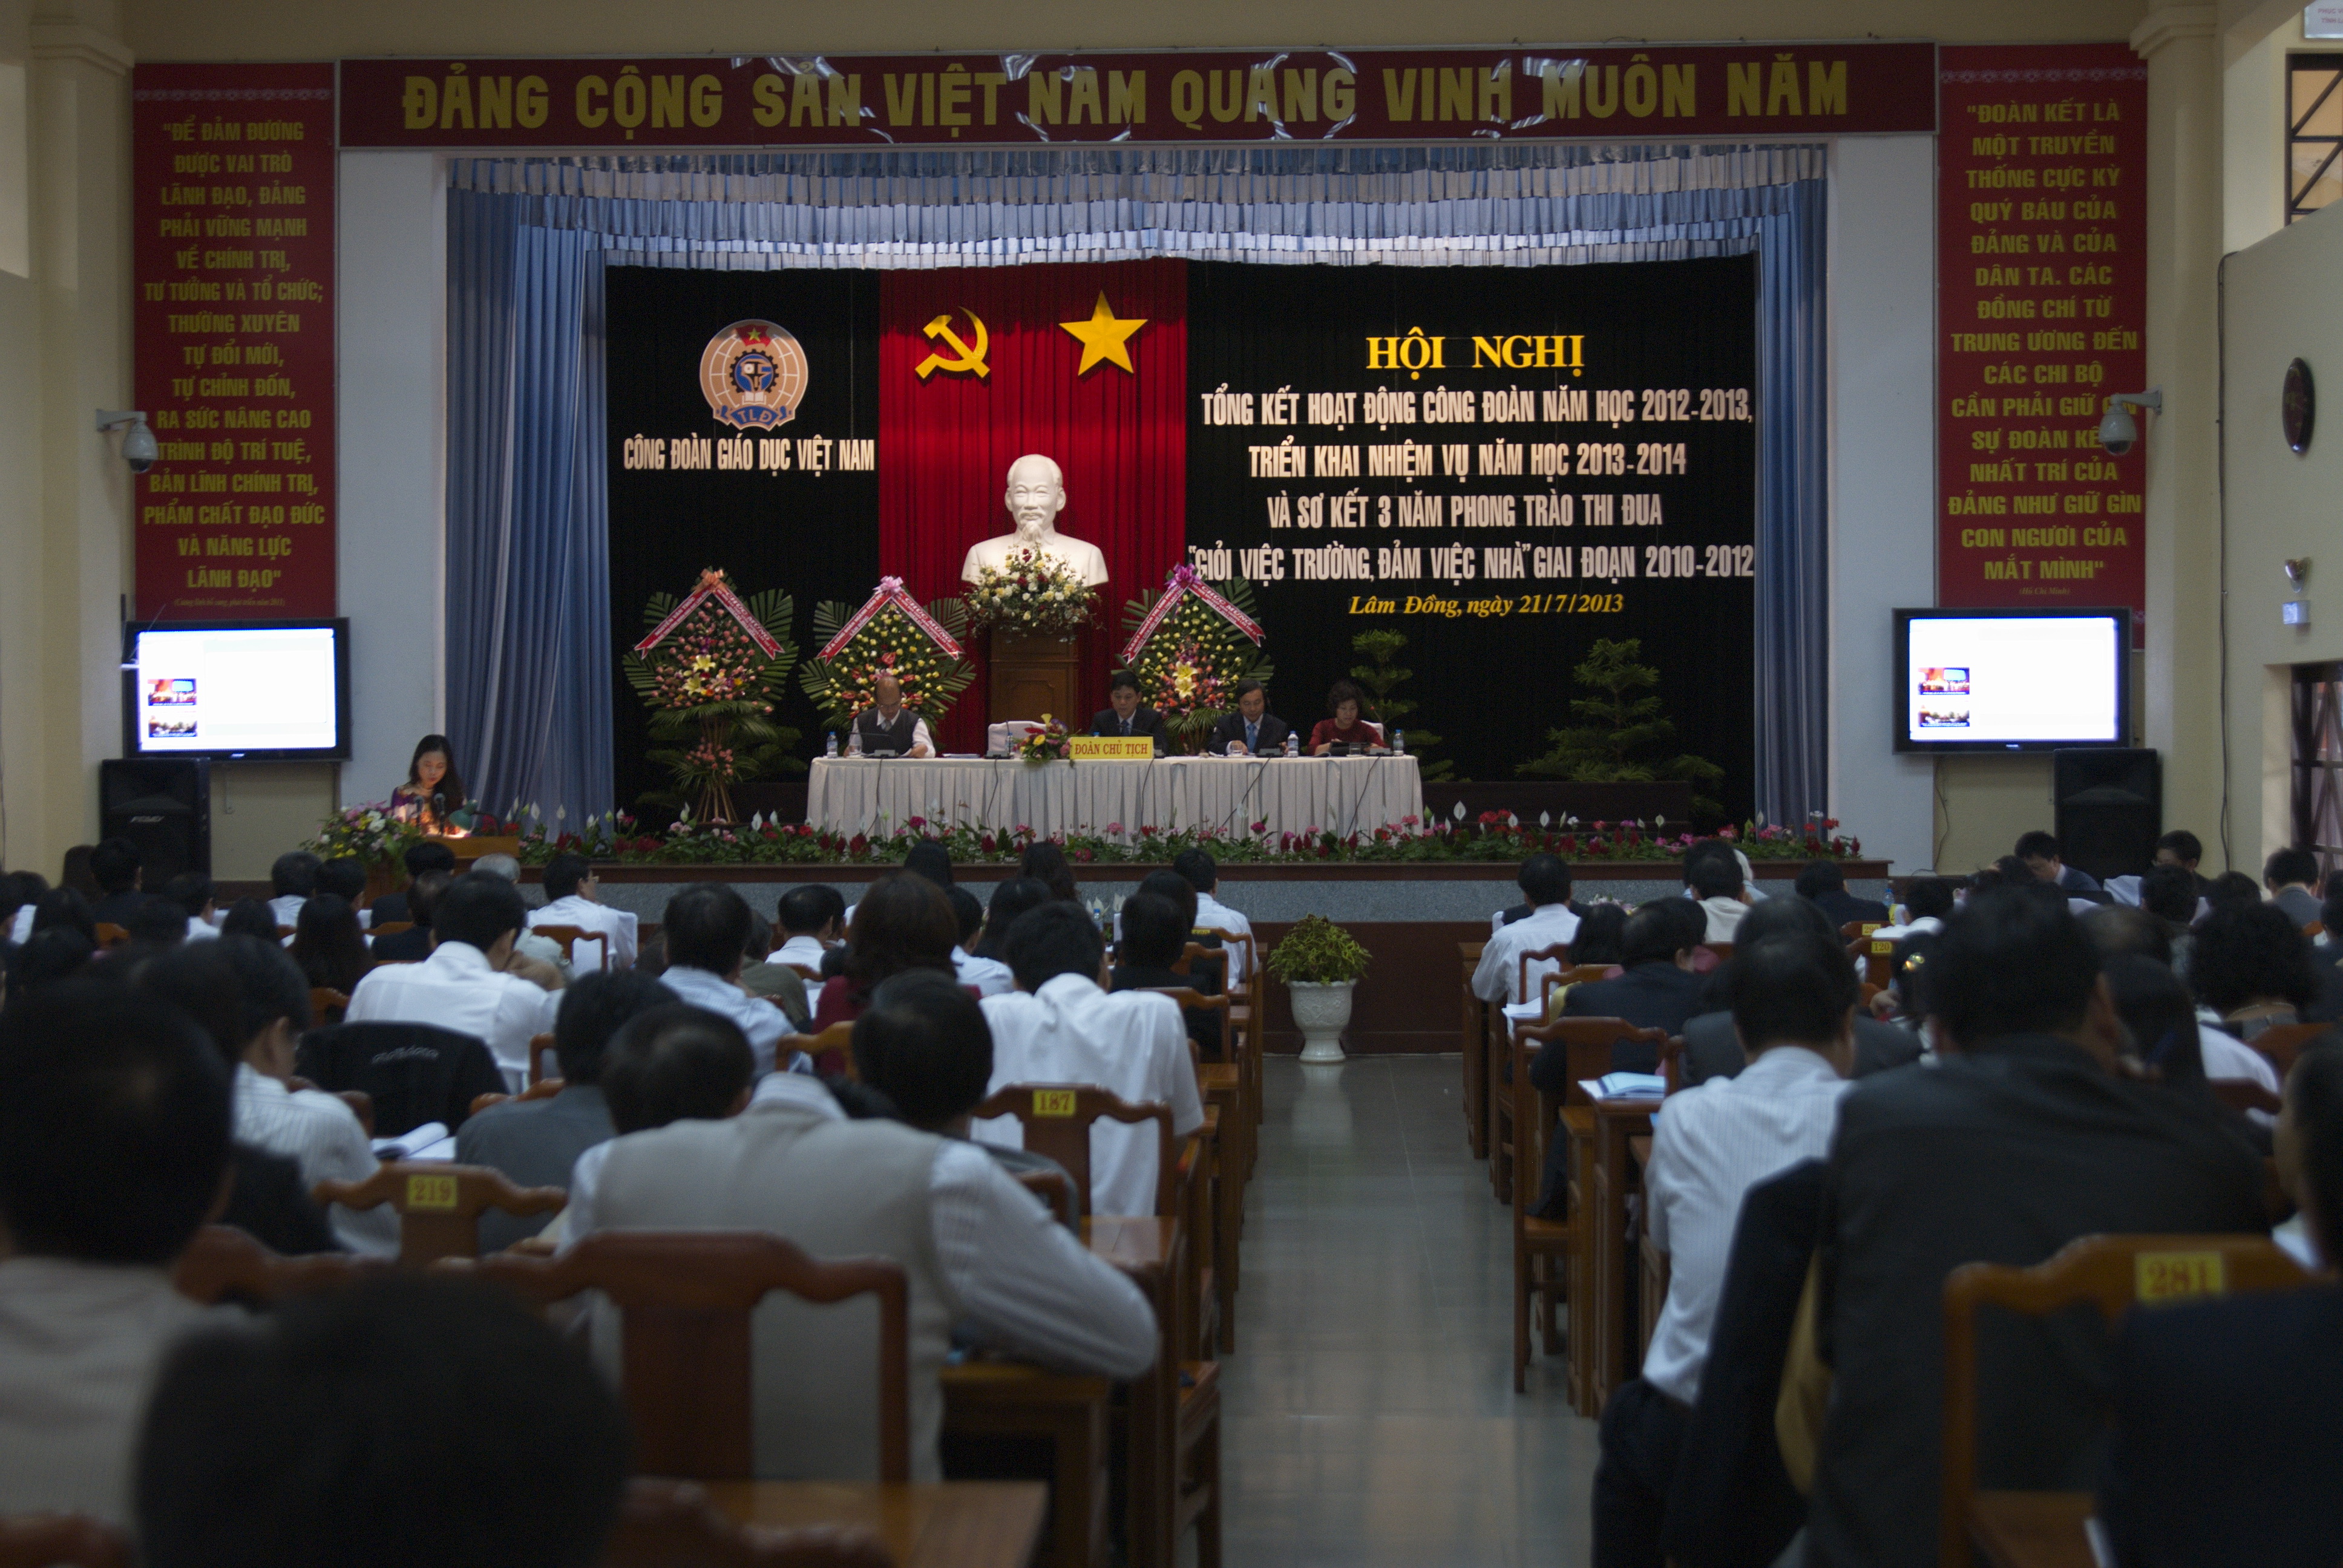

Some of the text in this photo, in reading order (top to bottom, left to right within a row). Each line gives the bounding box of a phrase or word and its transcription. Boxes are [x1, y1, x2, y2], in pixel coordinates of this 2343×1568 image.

[401, 53, 1848, 140] ĐẢNG CỘNG SẢN VIỆT NAM QUANG VINH MUÔN NĂM
[2044, 97, 2120, 122] KẾT LÀ
[201, 116, 304, 140] ĐẢM ĐƯƠNG
[1972, 128, 2115, 160] MỘT TRUYỀN
[174, 152, 254, 178] ĐƯỢC VAI
[1965, 163, 2122, 192] THỐNG CỰC KỲ
[161, 180, 306, 209] LÃNH ĐẠO, ĐẢNG
[1970, 194, 2117, 224] QUÝ BÁU CỦA
[160, 212, 307, 241] PHẢI VỮNG MẠNH
[1971, 227, 2117, 254] ĐẢNG VÀ CỦA
[205, 247, 290, 273] CHÍNH TRỊ,
[1976, 263, 2112, 286] DÂN TA. CÁC
[144, 280, 166, 301] TƯ
[226, 278, 246, 301] VÀ
[252, 275, 272, 301] TỔ
[1977, 293, 2113, 319] ĐỒNG CHÍ TỪ
[241, 310, 300, 333] XUYÊN
[1951, 325, 2138, 351] TRUNG ƯƠNG ĐẾN
[184, 345, 206, 370] TỰ
[211, 339, 240, 364] ĐỔI
[1366, 326, 1585, 381] HỘI NGHỊ
[1984, 361, 2103, 387] CÁC CHI BỘ
[172, 373, 296, 402] TỰ CHỈNH ĐỐN,
[738, 410, 772, 423] TLĐ
[1201, 382, 1753, 431] TỔNG KẾT HOẠT ĐỘNG CÔNG ĐOÀN NĂM HỌC 2012-2013,
[1951, 391, 2097, 417] CẦN PHẢI GIỮ
[157, 407, 312, 429] RA SỨC NÂNG CAO
[159, 439, 312, 465] TRÌNH ĐỘ TRÍ TUỆ,
[1972, 426, 2068, 454] SỰ ĐOÀN
[624, 432, 874, 477] CÔNG ĐOÀN GIÁO DỤC VIỆT NAM
[1248, 434, 1686, 483] TRIỂN KHAI NHIỆM VỤ NĂM HỌC 2013-2014
[150, 468, 318, 495] BẢN LĨNH CHÍNH TRỊ,
[1970, 456, 2117, 483] NHẤT TRÍ CỦA
[144, 498, 325, 529] PHẨM CHẤT ĐẠO ĐỨC
[1267, 487, 1662, 528] VÀ SƠ KẾT 3 NĂM PHONG TRÀO THI ĐUA
[1947, 490, 2141, 515] ĐẢNG NHƯ GIỮ GÌN
[178, 534, 292, 560] VÀ NĂNG LỰC
[1961, 521, 2127, 547] CON CỦA
[1240, 539, 1754, 587] VIỆC TRƯỜNG, ĐẢM VIỆC GIAI ĐOẠN 2010-2012
[1984, 554, 2033, 580] MẮT
[187, 566, 232, 588] LÃNH
[1349, 593, 1624, 617] Lâm Đồng, ngày 21/7/2013
[1075, 740, 1148, 756] ĐOÀN CHỦ TỊCH
[1039, 1094, 1070, 1111] 187
[415, 1178, 451, 1201] 219
